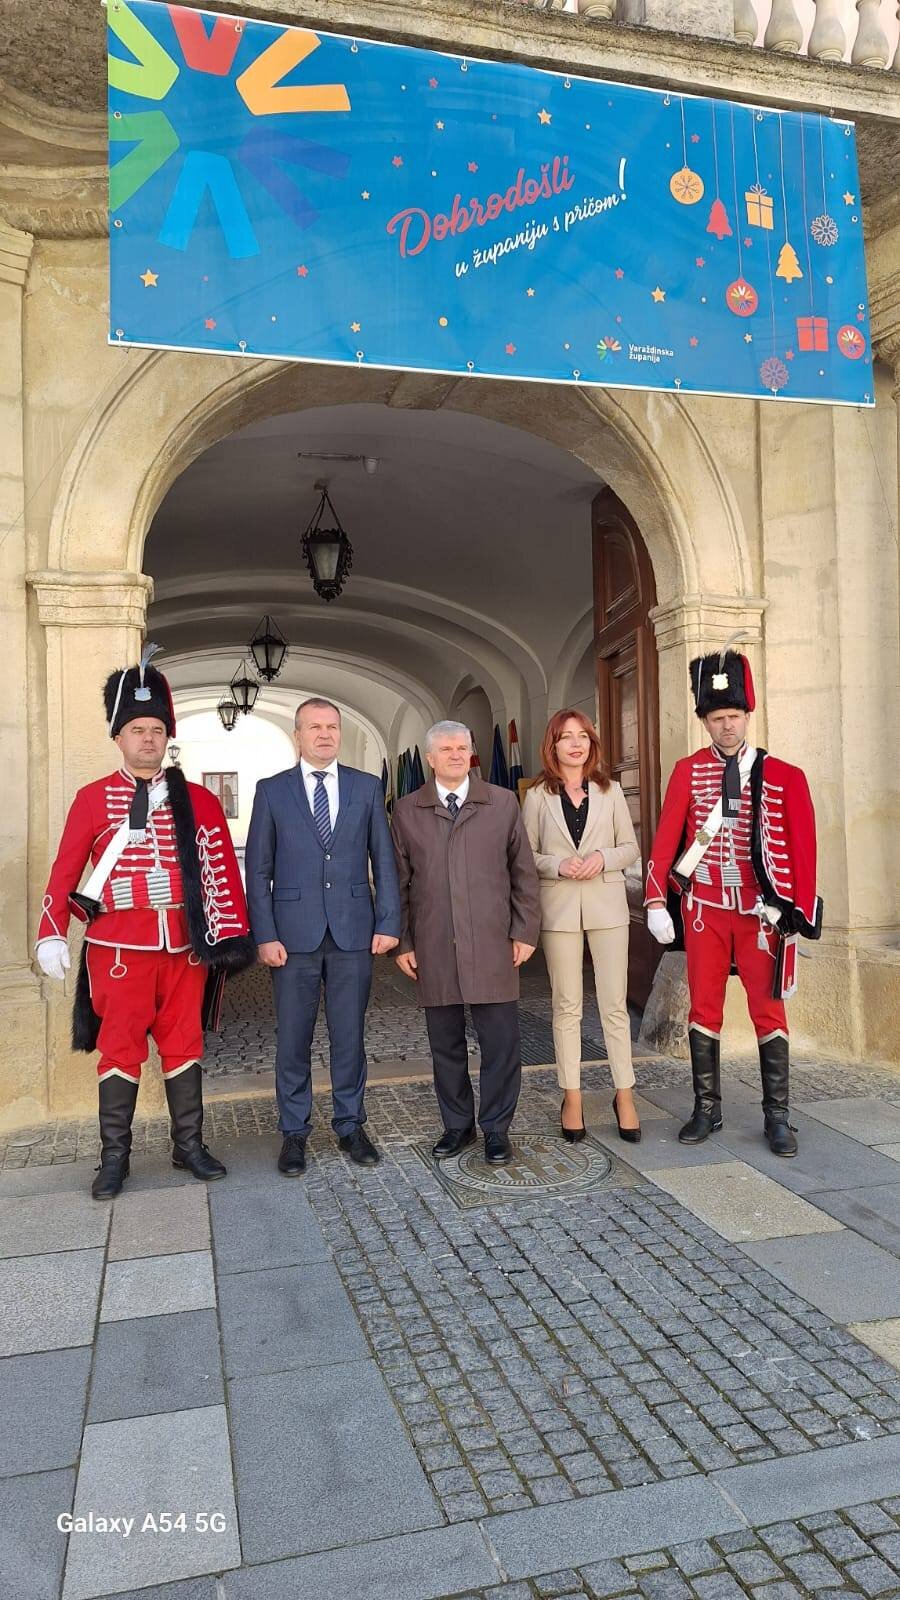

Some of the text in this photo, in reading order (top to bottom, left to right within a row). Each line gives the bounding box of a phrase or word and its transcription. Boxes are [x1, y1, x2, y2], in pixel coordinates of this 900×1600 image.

[386, 155, 576, 258] Dobrodošli
[455, 259, 469, 278] u
[472, 220, 550, 268] županiju
[552, 219, 560, 232] s
[628, 343, 674, 357] Varaždinska
[629, 351, 661, 364] županija
